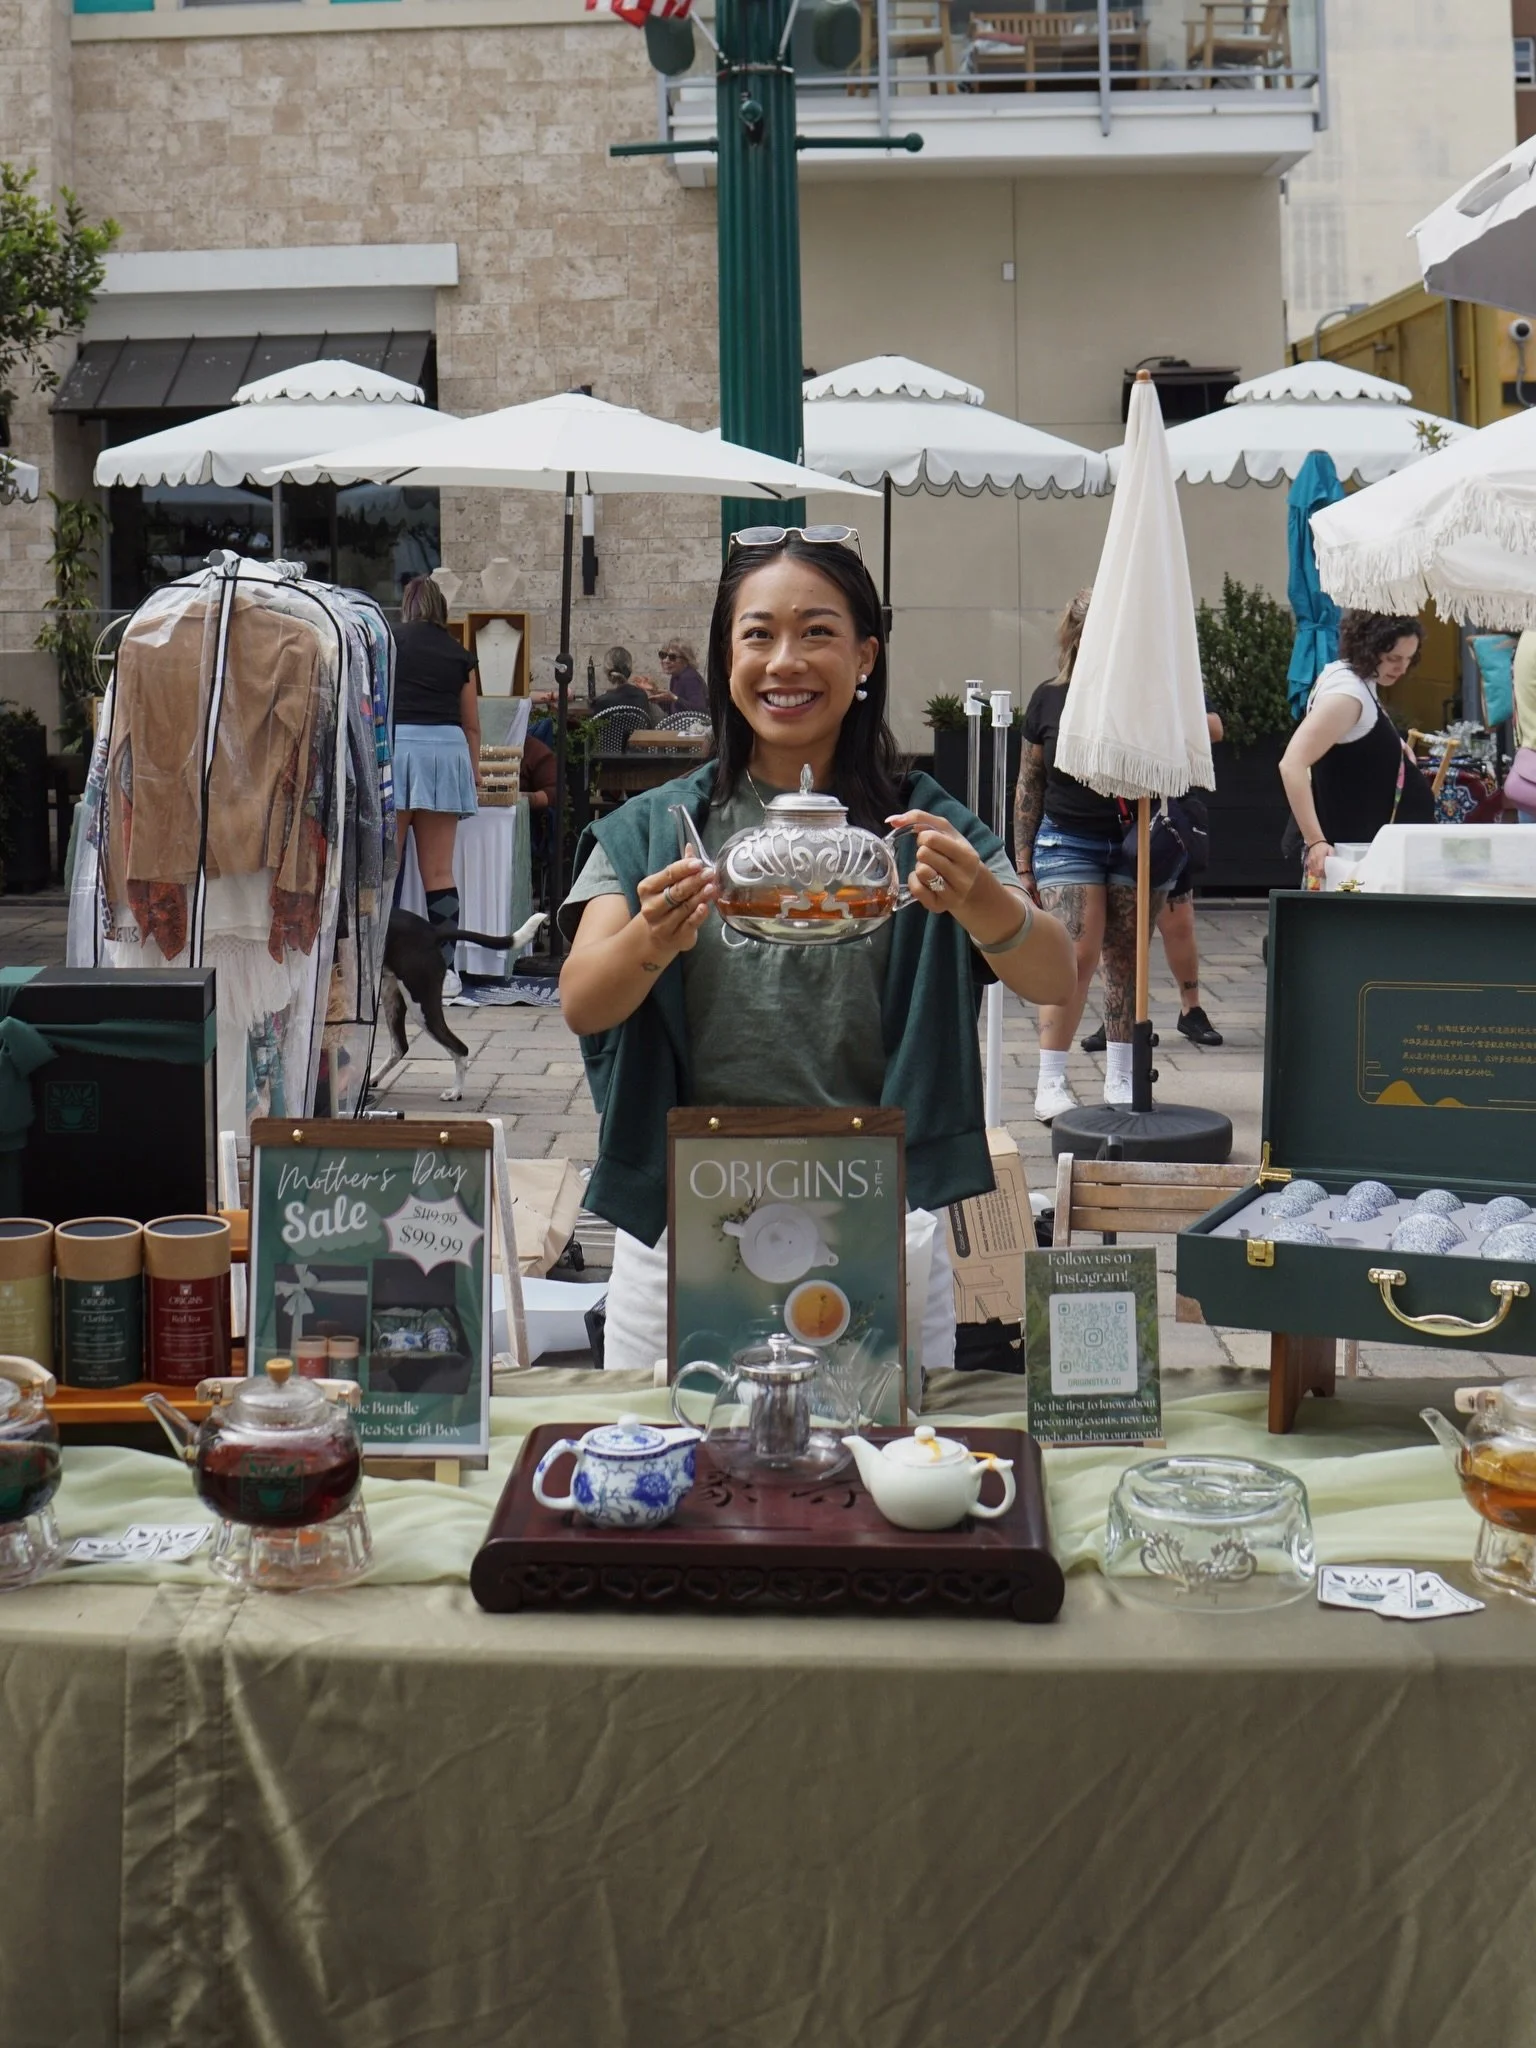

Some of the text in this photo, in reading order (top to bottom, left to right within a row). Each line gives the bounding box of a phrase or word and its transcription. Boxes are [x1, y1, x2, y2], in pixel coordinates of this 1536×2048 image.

[277, 1151, 468, 1200] Mother's Day
[689, 1159, 869, 1199] ORIGINS
[874, 1159, 884, 1197] TEA
[281, 1195, 368, 1243] Sale
[400, 1225, 464, 1256] $99.99
[1048, 1252, 1132, 1266] Follow us on
[1056, 1270, 1128, 1287] Instagram!
[372, 1402, 419, 1415] Bundle
[1034, 1398, 1156, 1412] Be the first to know about
[358, 1422, 460, 1436] Tea Set Gift Box
[1034, 1416, 1084, 1430] upcoming
[1120, 1416, 1140, 1424] new
[1142, 1414, 1158, 1424] tea
[1064, 1430, 1083, 1440] and
[1085, 1429, 1108, 1440] shop
[1110, 1431, 1128, 1440] our
[1130, 1428, 1161, 1439] merch
